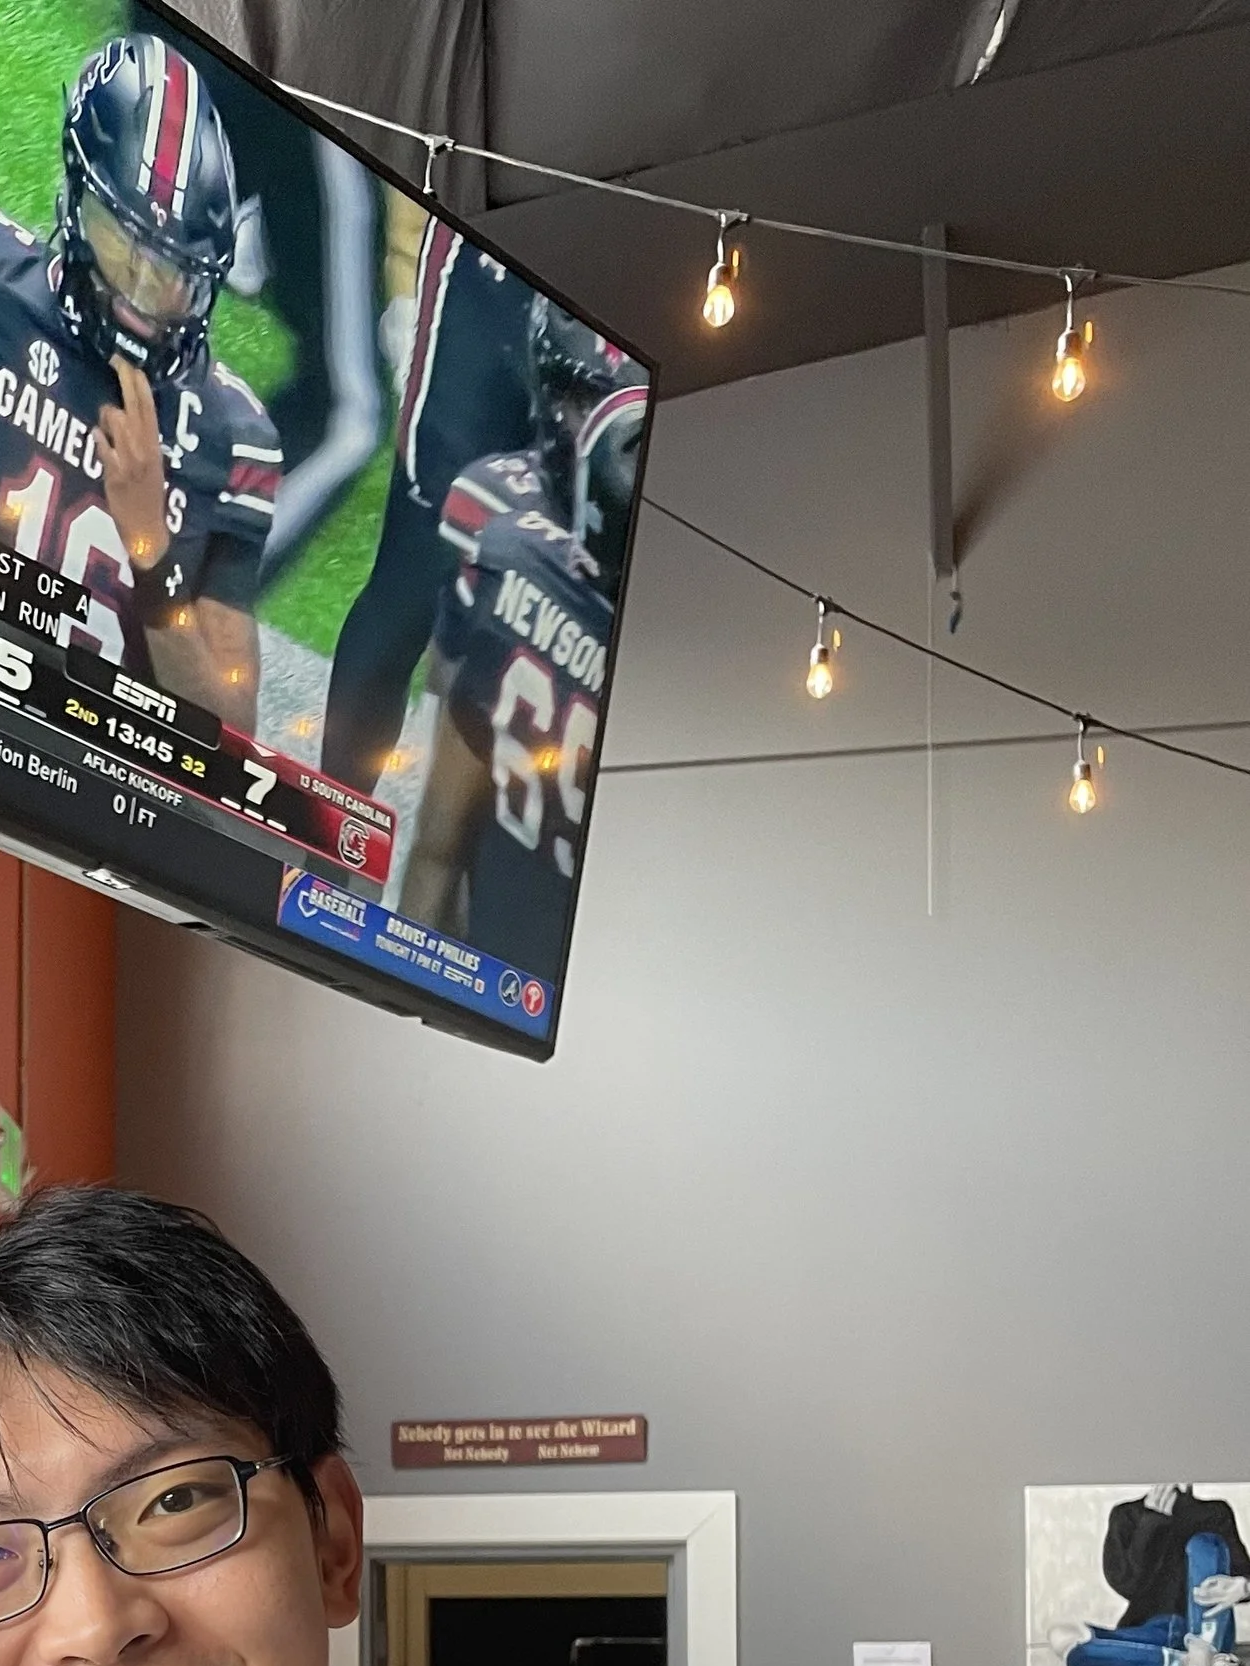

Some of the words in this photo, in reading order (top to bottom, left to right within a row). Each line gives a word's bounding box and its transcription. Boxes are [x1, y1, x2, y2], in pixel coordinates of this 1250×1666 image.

[28, 340, 61, 387] SEC
[36, 573, 64, 599] OF
[76, 594, 89, 616] A
[19, 601, 59, 638] RUN
[112, 673, 177, 723] ESPN
[65, 698, 99, 727] 2ND
[106, 716, 174, 764] 13:45
[180, 755, 206, 779] 32
[27, 756, 78, 794] Berlin
[112, 794, 126, 815] 0
[137, 810, 157, 828] FT
[82, 752, 128, 784] AFLAC
[128, 773, 183, 807] KICKOFF
[243, 758, 277, 806] 7
[300, 774, 310, 789] 13
[312, 779, 345, 806] SOUTH
[345, 796, 391, 829] CAROLINA
[398, 1424, 451, 1445] Nobody
[489, 1422, 504, 1440] in
[554, 1420, 577, 1438] the
[581, 1418, 636, 1437] Wizard
